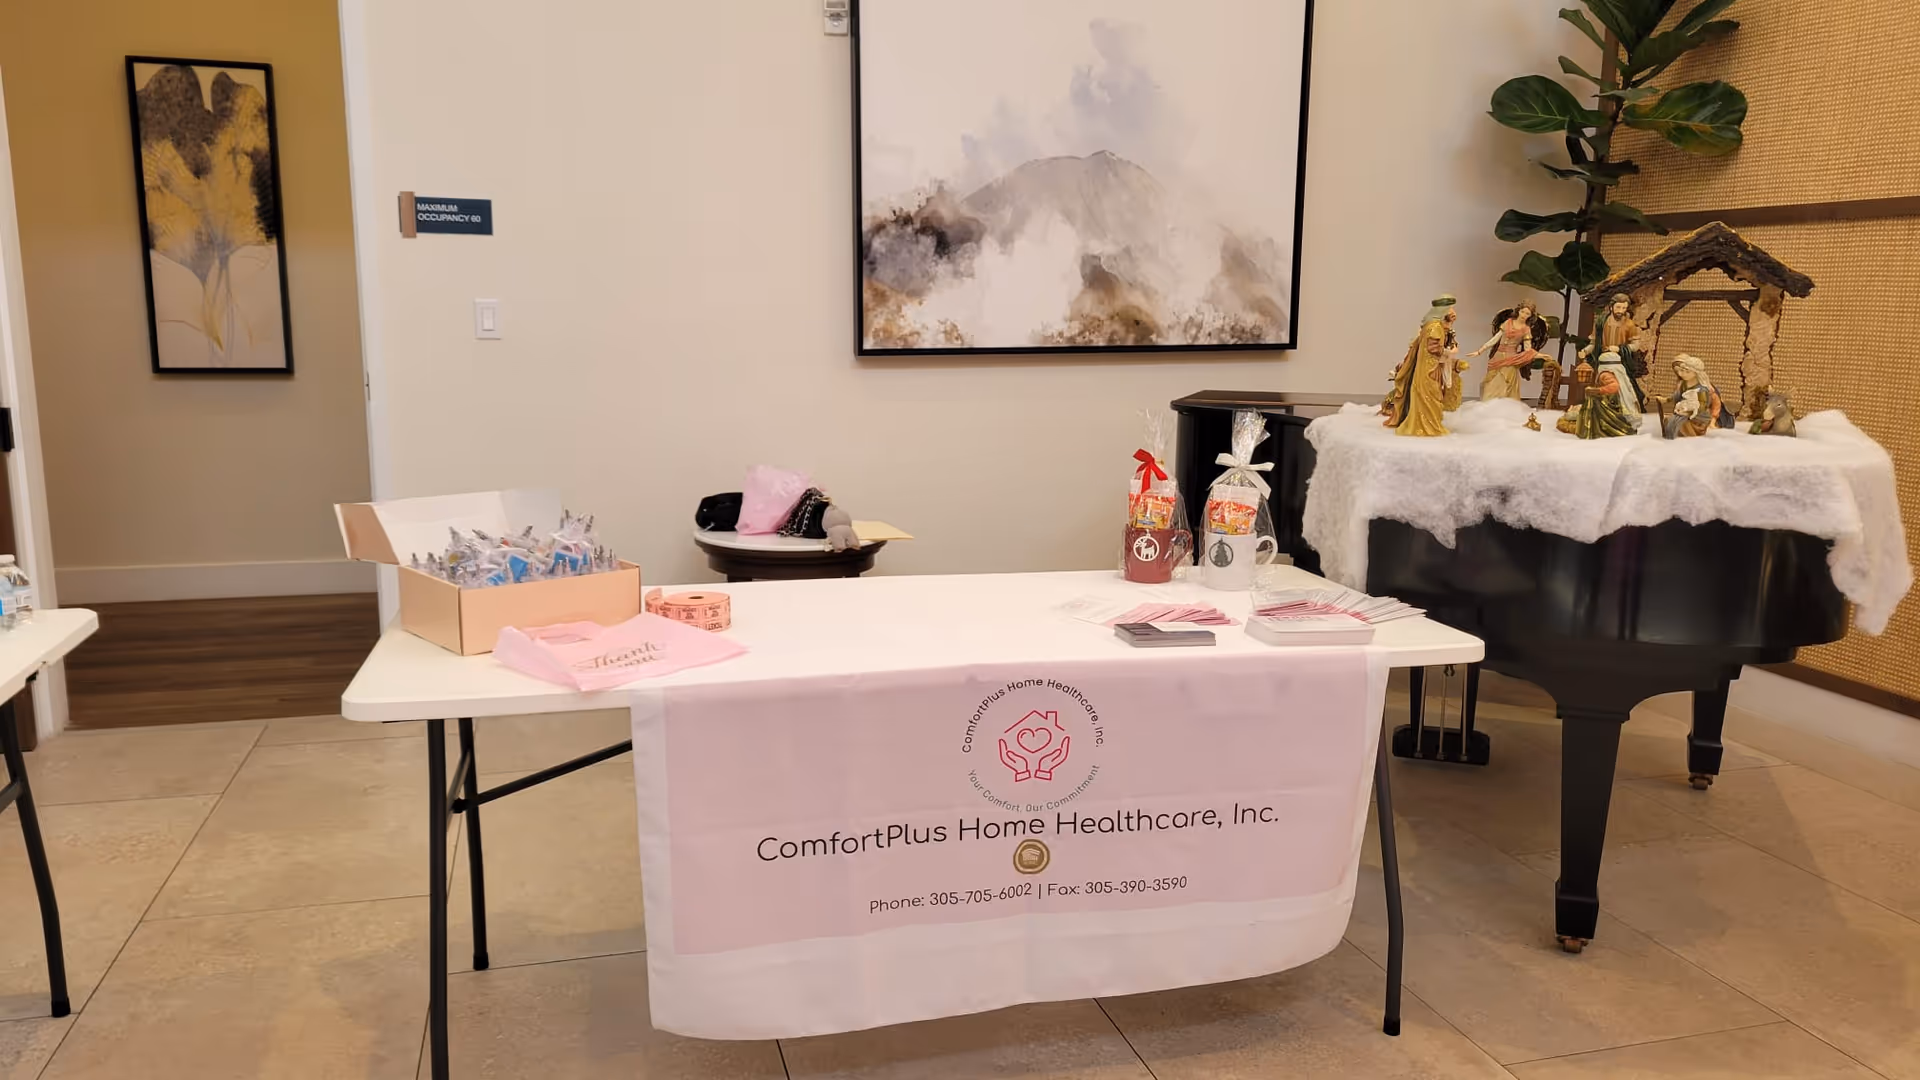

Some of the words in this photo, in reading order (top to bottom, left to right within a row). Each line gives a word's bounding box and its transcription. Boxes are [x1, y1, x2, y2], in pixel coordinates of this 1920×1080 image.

[417, 203, 458, 212] MAXIMUM
[417, 213, 470, 222] OCCUPANCY
[471, 215, 481, 223] 60
[962, 687, 1006, 753] ComfortPlus
[1006, 678, 1043, 692] Home
[1047, 679, 1099, 725] Healthcare,
[1095, 726, 1104, 748] Inc.
[968, 769, 984, 792] Your
[1025, 804, 1043, 812] Our
[1046, 764, 1100, 811] Commitment
[757, 823, 947, 862] ComfortPlus
[959, 817, 1045, 841] Home
[1056, 808, 1223, 835] Healthcare,
[1233, 803, 1280, 825] Inc.
[869, 895, 925, 914] Phone:
[929, 882, 1032, 906] 305-705-6002
[1047, 882, 1080, 897] Fax:
[1084, 876, 1188, 895] 305-390-3590
